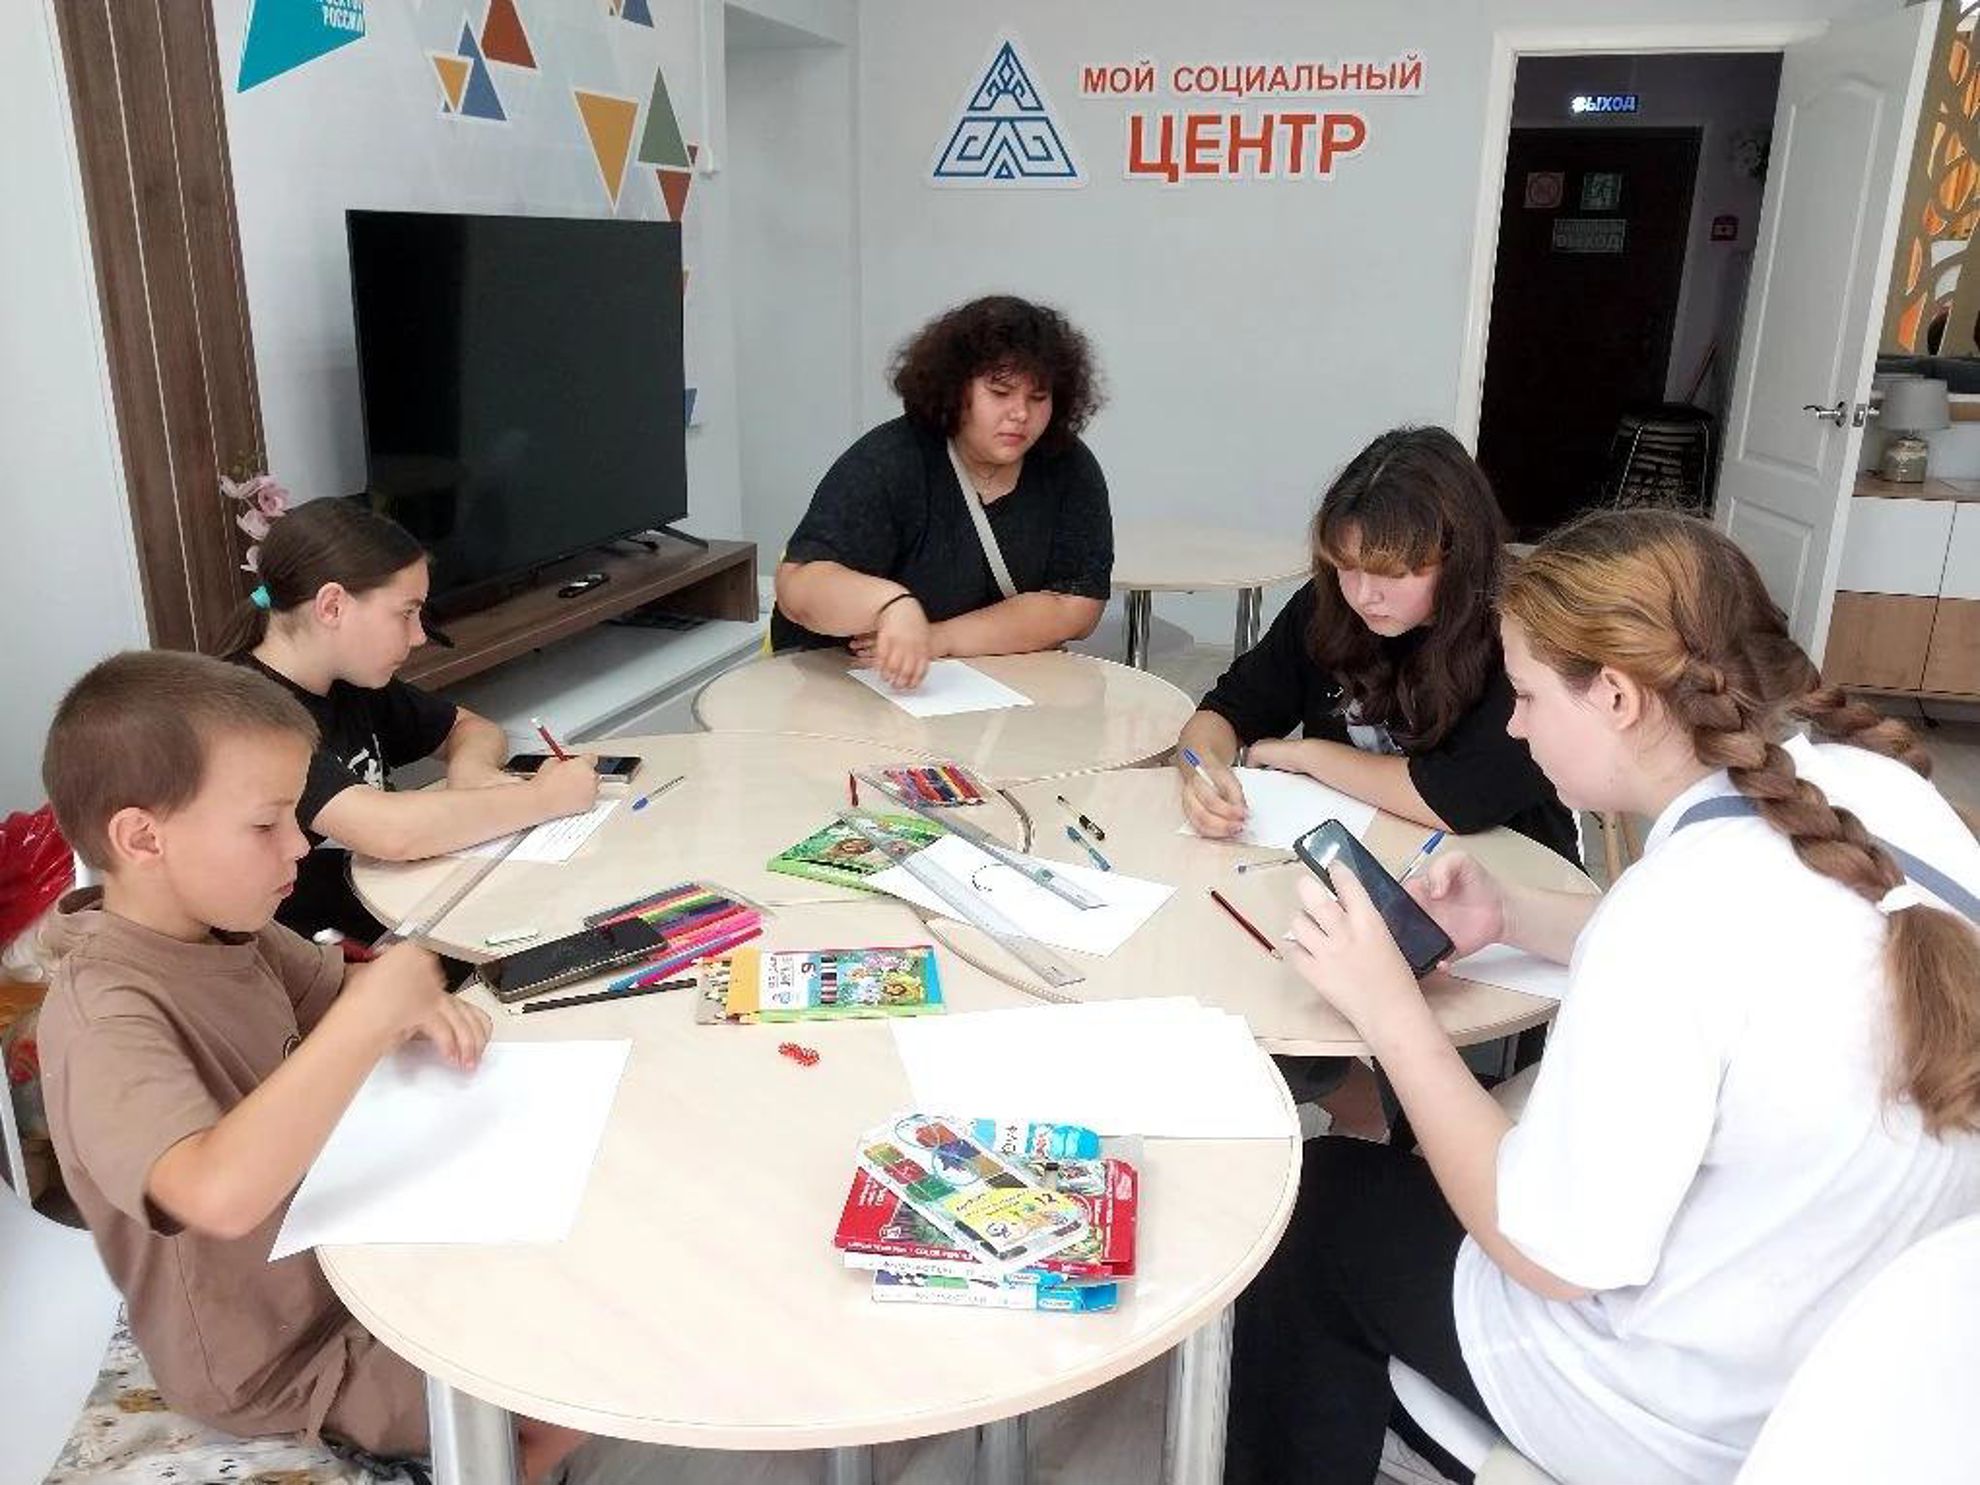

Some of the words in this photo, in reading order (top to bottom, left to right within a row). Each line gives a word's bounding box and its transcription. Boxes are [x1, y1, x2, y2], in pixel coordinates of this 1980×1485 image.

[1084, 60, 1154, 93] МОЙ
[1174, 54, 1422, 97] СОЦИАЛЬНЫЙ
[1129, 114, 1367, 182] ЦЕНТР
